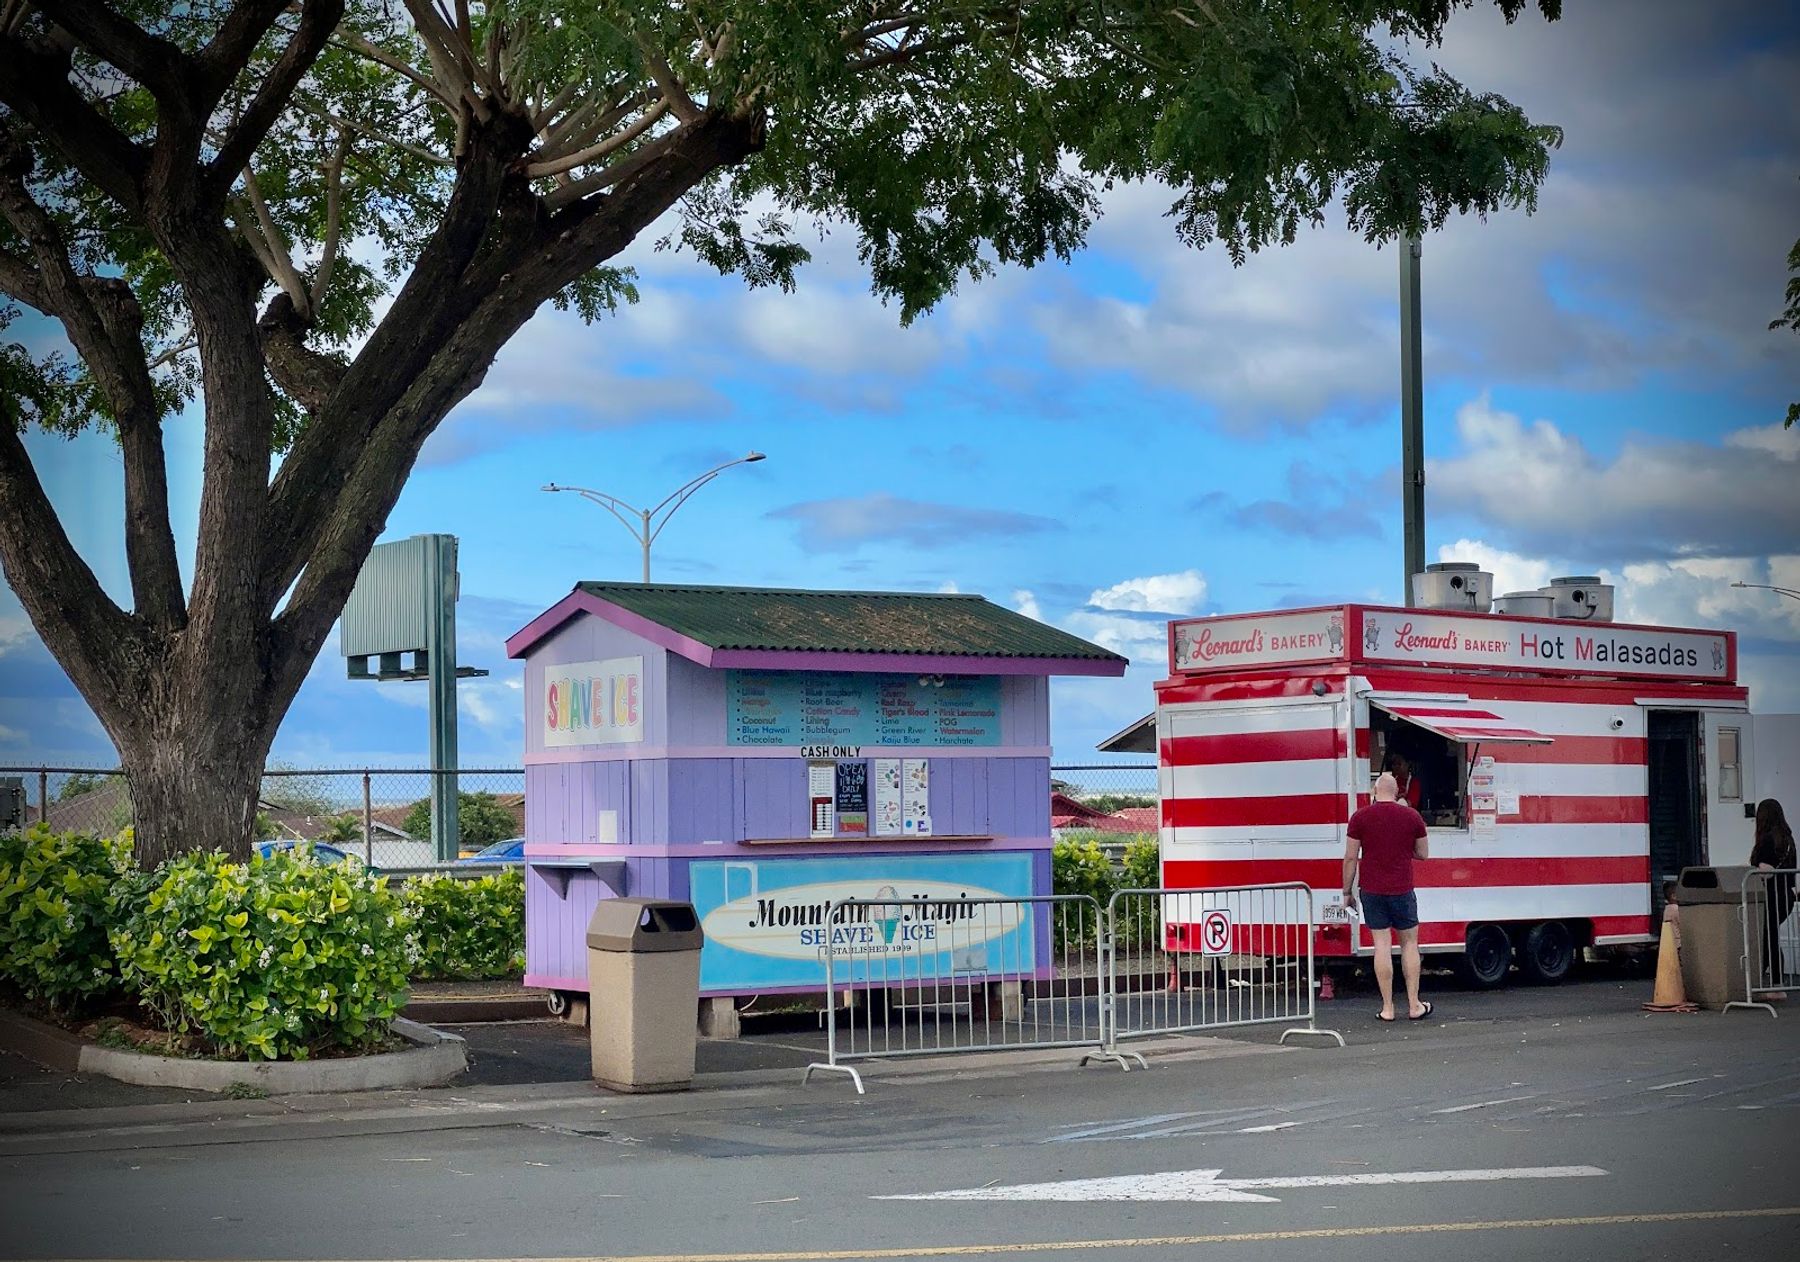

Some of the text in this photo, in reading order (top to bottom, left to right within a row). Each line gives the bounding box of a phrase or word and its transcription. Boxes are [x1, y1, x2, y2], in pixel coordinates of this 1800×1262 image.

[1192, 628, 1325, 661] Leonard's BAKERY
[1394, 622, 1698, 667] Leonard's BAKERY Hot Malasadas
[548, 674, 638, 732] SHAVE ICE
[806, 698, 844, 706] Root Beer
[806, 707, 860, 717] Cotton Candy
[907, 707, 930, 717] Blood
[940, 708, 996, 717] Pink Lemonade
[742, 717, 777, 725] Coconut
[882, 717, 899, 725] Lime
[940, 718, 958, 726] POG
[742, 726, 790, 734] Blue Hawaii
[806, 726, 851, 736] Bubblegum
[882, 726, 926, 734] Green River
[940, 726, 985, 736] Watermelon
[742, 735, 783, 744] Chocolate
[882, 736, 921, 745] Kaiju Blue
[801, 746, 861, 758] CASH ONLY
[838, 763, 867, 777] OPEN
[749, 896, 870, 928] Mountain
[801, 924, 935, 945] SHAVE ICE
